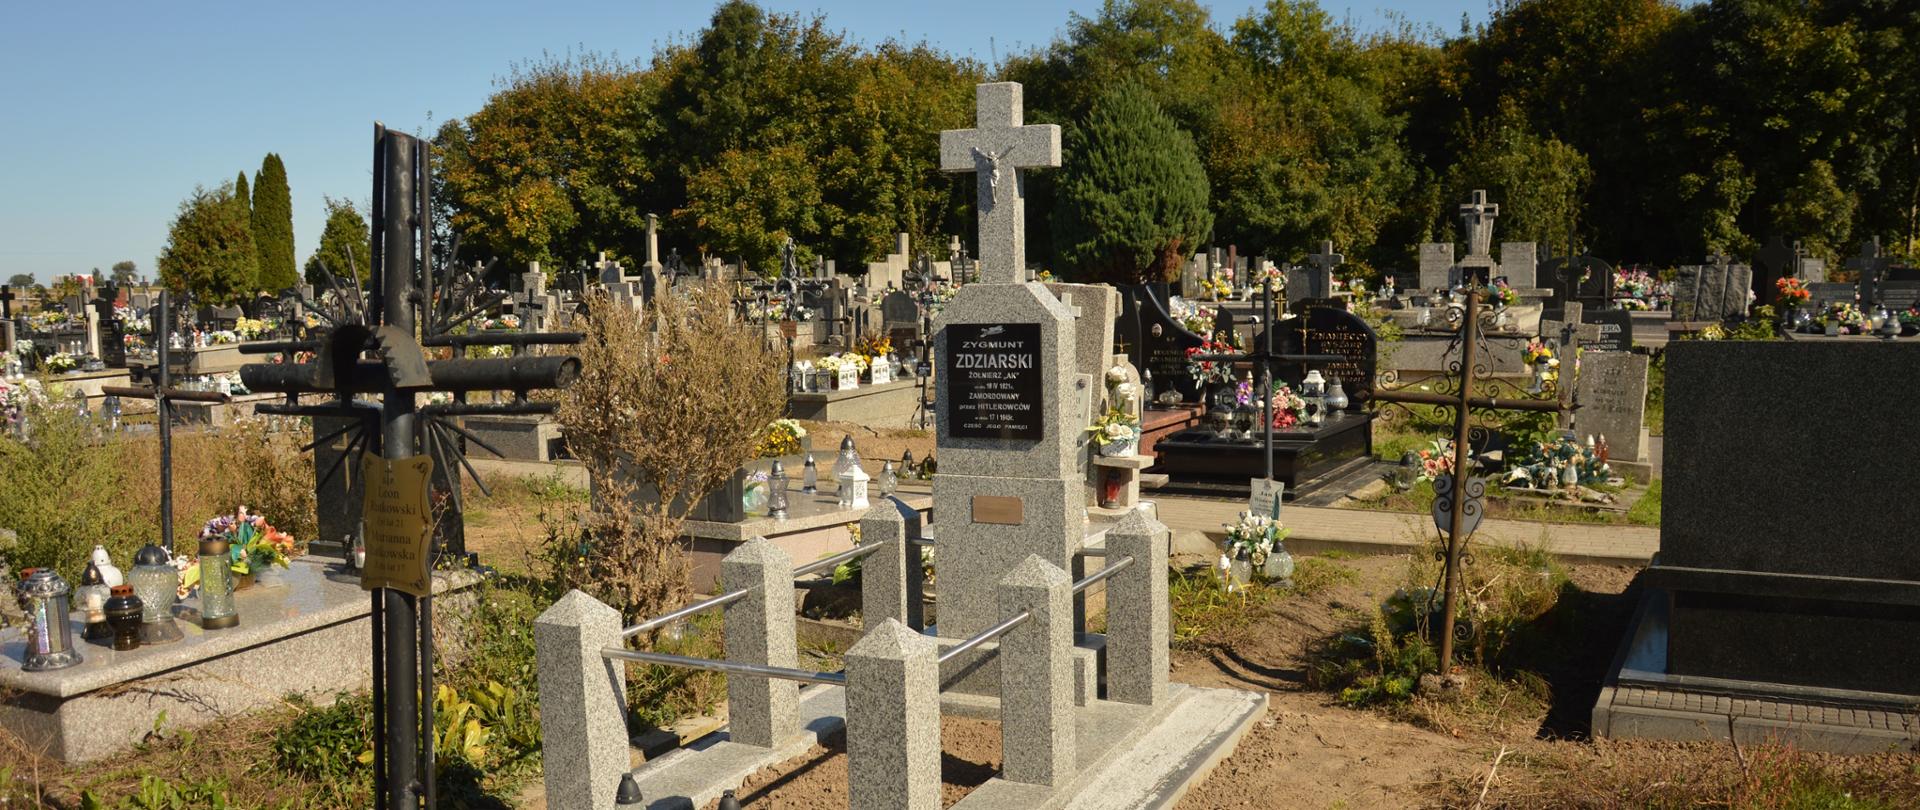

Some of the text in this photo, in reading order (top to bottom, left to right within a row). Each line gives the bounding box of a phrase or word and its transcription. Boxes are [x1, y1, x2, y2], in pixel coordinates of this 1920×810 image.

[962, 341, 1024, 349] ZYGMUNT
[955, 353, 1033, 369] ZDZIARSKI
[968, 371, 1002, 379] ŻOŁNIERZ
[968, 392, 1020, 400] ZAMORDOWANY
[977, 402, 1031, 411] HITLEROWCÓW
[378, 486, 400, 499] Leon
